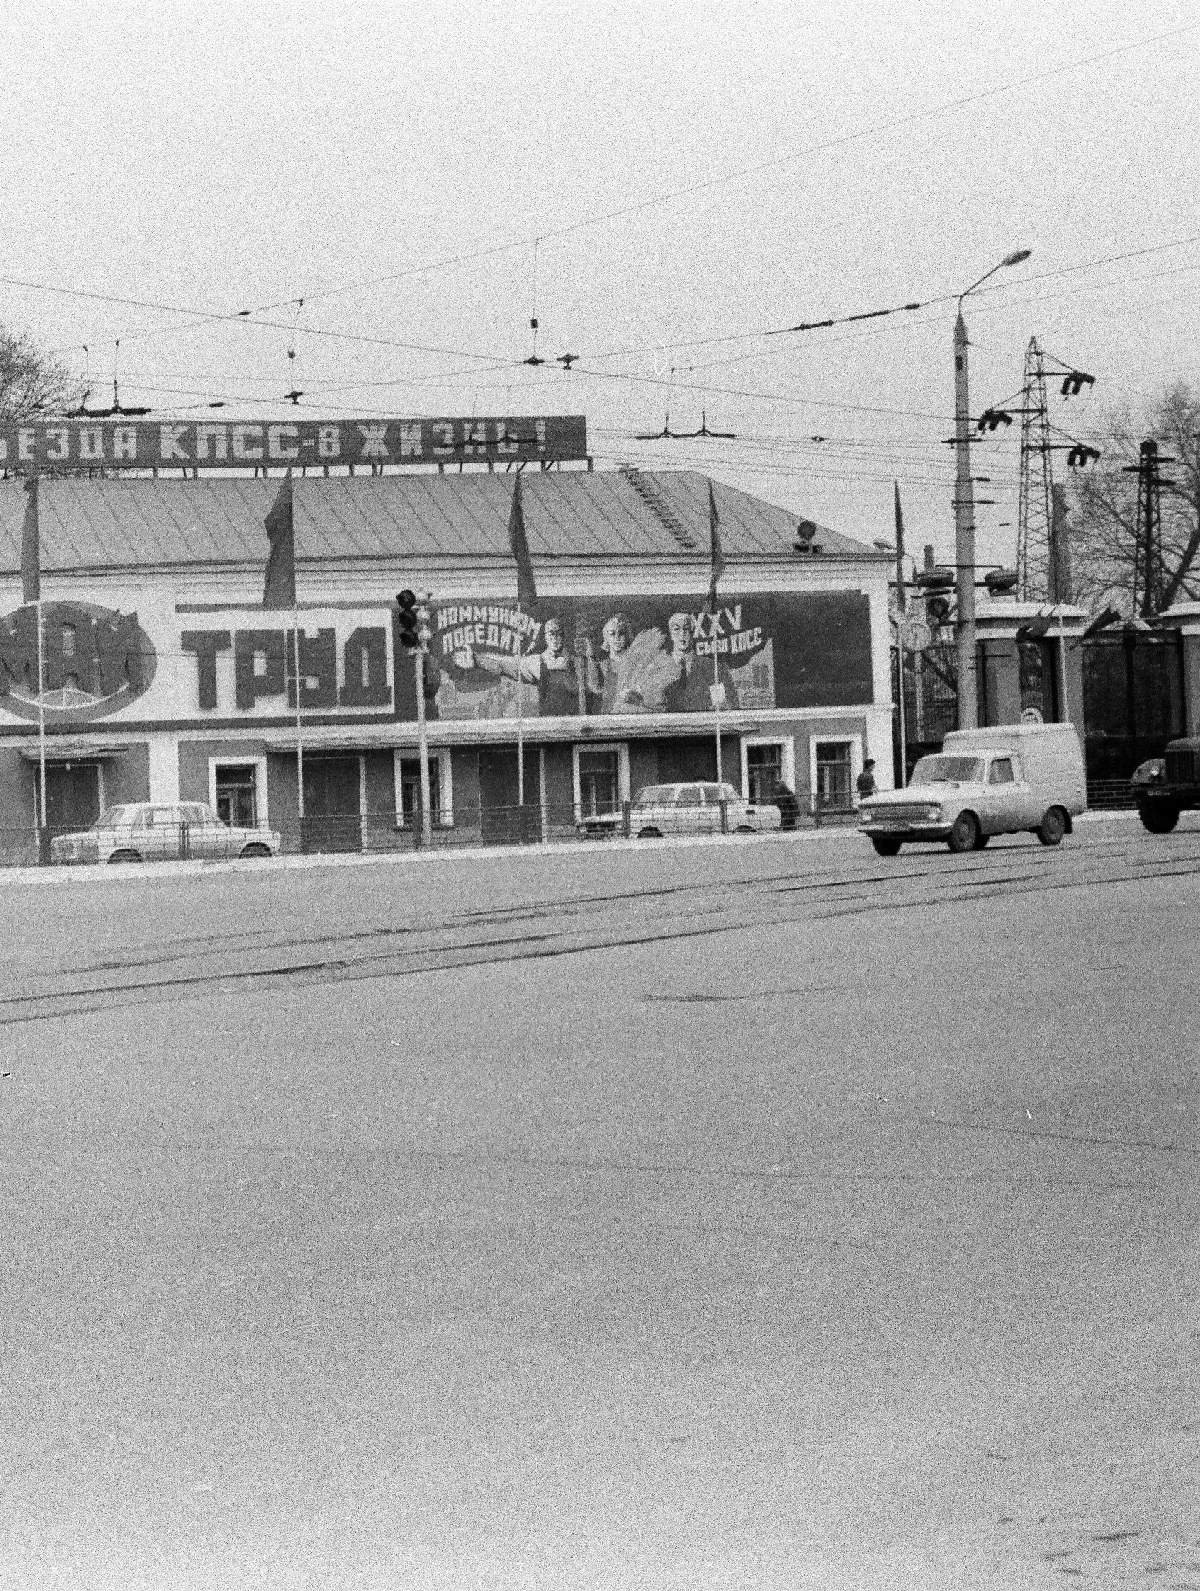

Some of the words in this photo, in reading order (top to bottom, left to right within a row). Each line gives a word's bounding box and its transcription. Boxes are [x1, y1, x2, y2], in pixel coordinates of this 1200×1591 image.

[357, 420, 547, 457] ЖИЗНЬ!
[437, 605, 542, 638] КОММУНИЗМ
[692, 604, 743, 638] XXV
[181, 626, 392, 709] ТРУД
